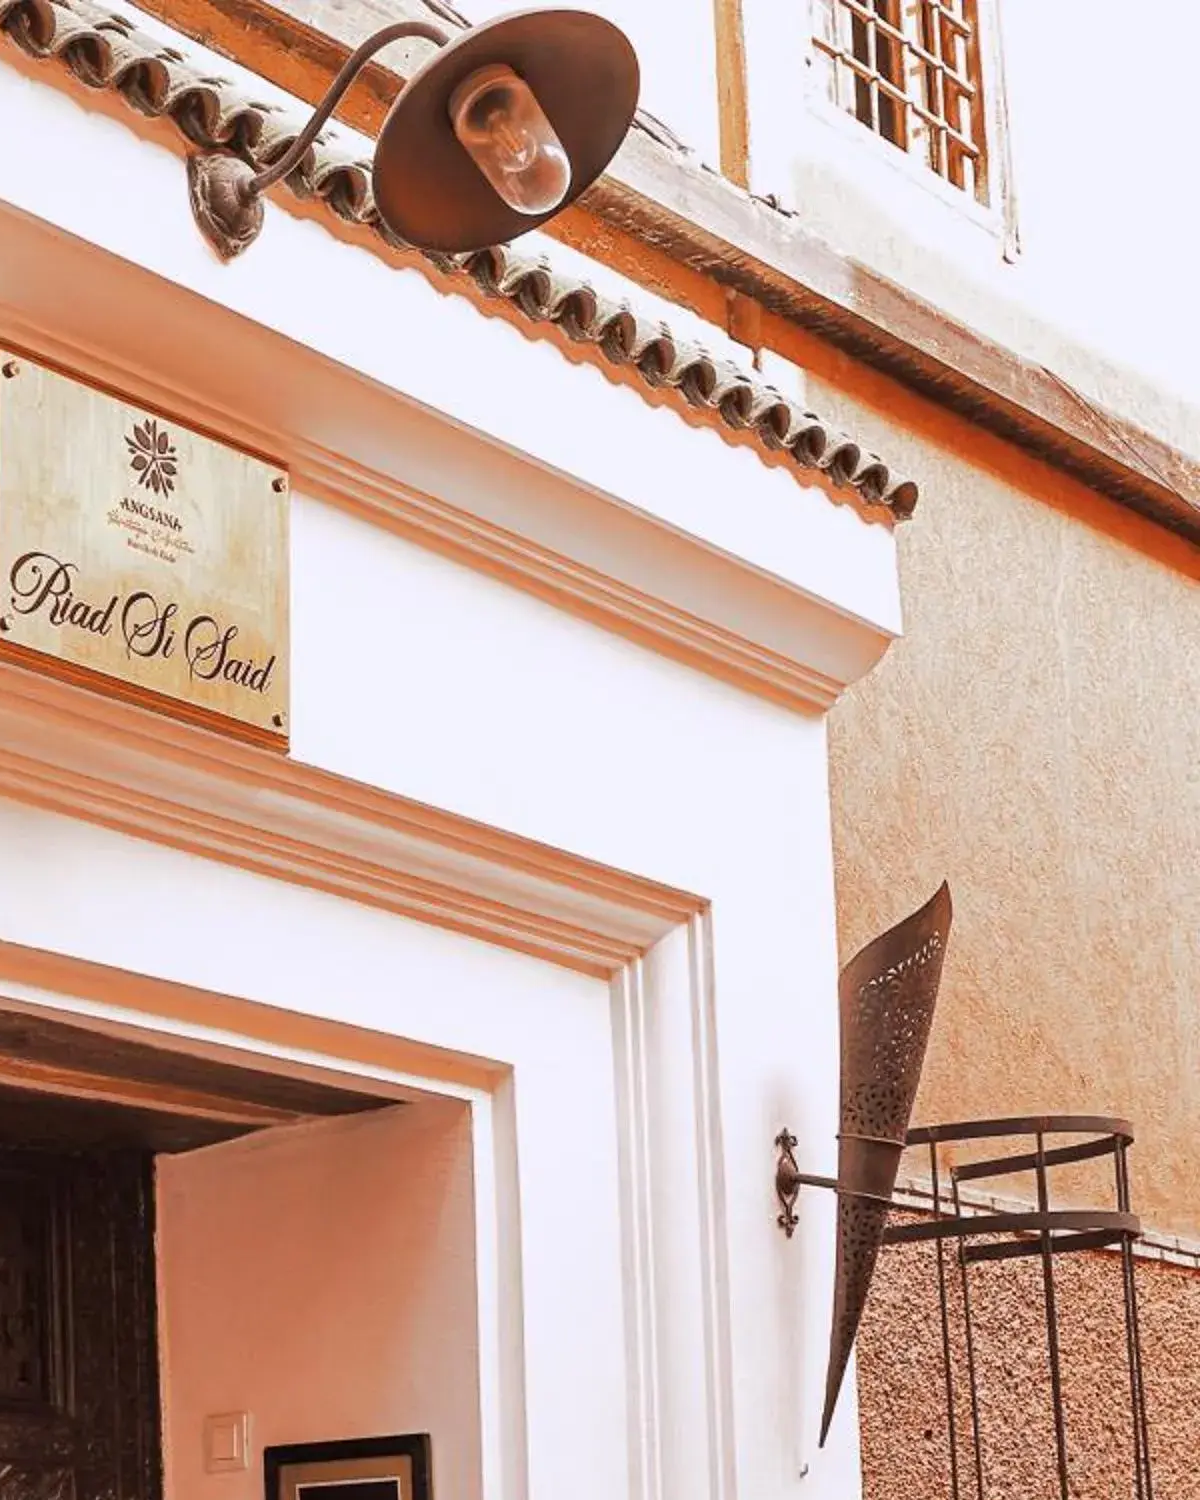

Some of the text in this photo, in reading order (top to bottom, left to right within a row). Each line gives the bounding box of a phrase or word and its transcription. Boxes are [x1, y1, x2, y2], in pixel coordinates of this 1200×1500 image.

[119, 497, 183, 532] ANGSANA
[10, 551, 277, 693] Riad Si Said
